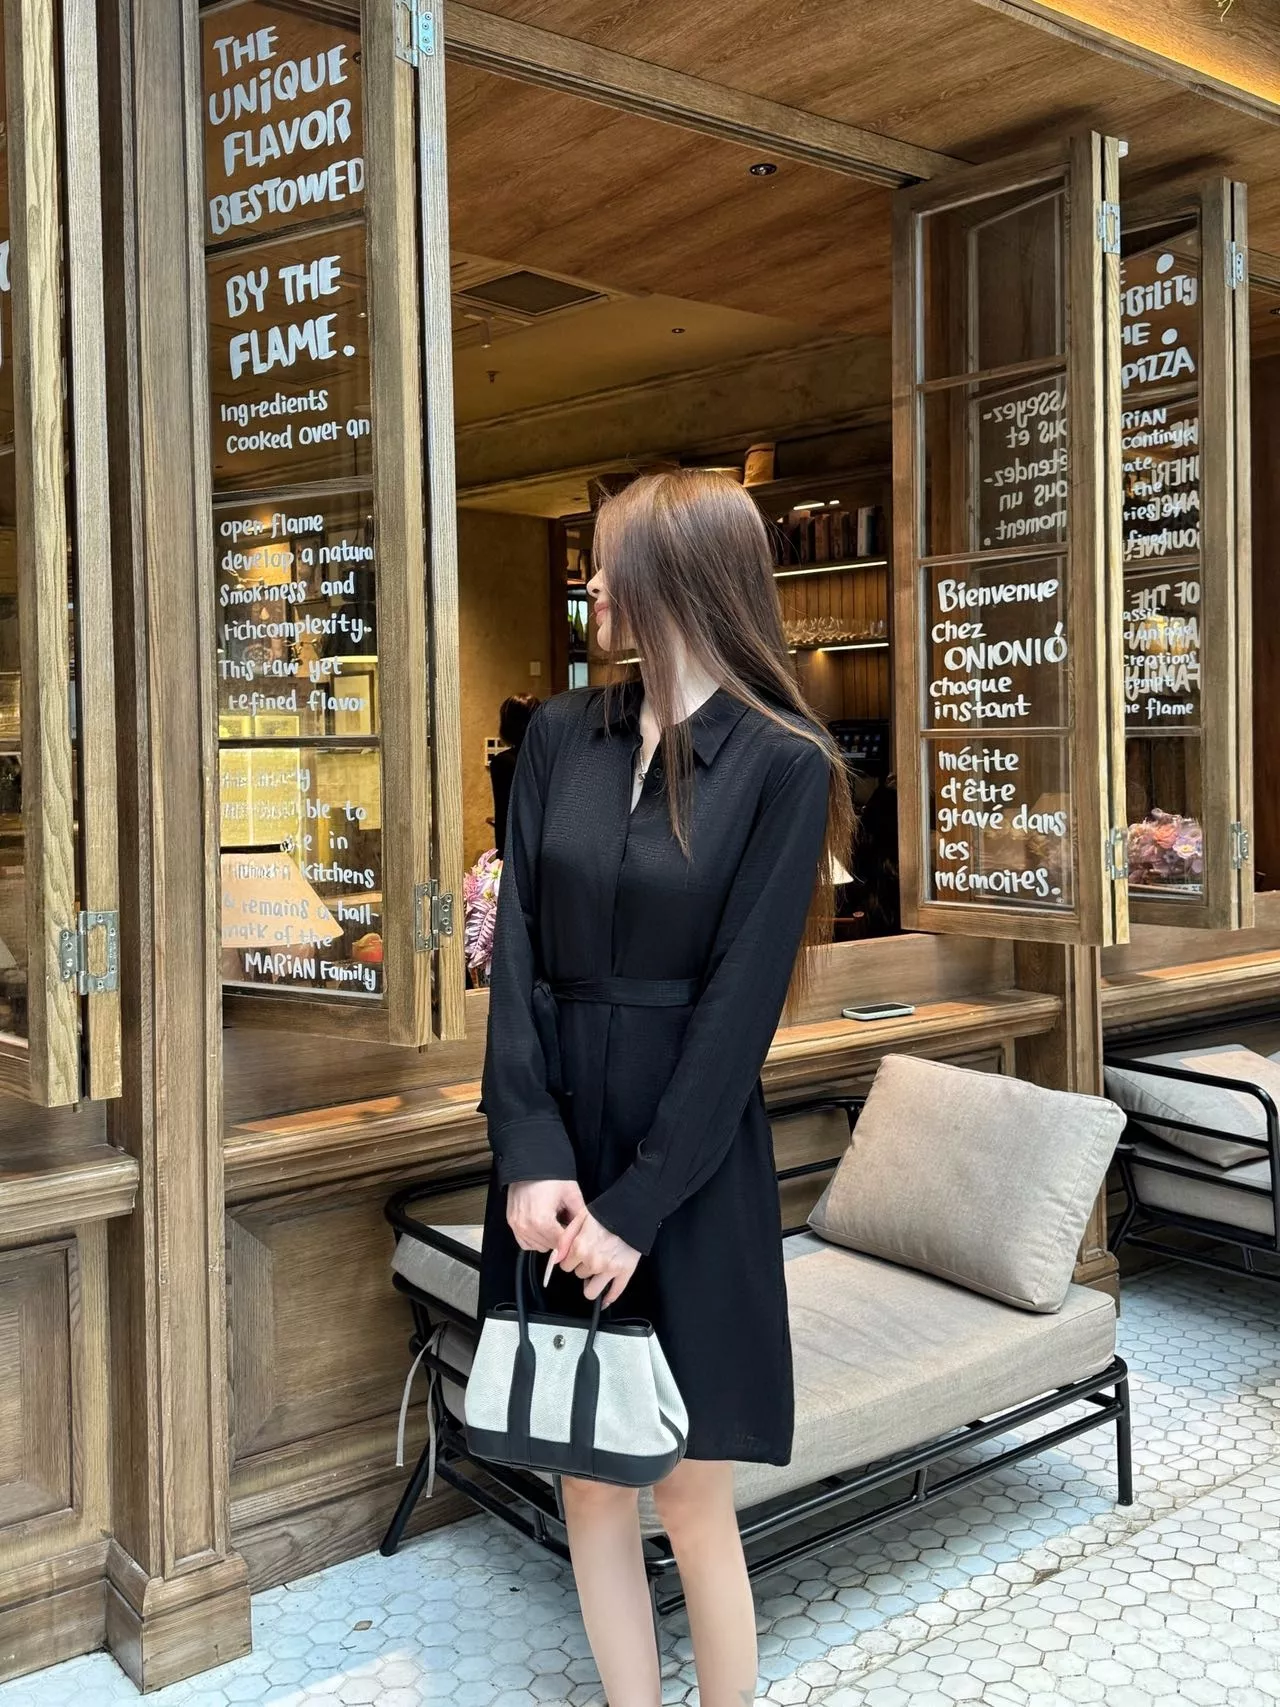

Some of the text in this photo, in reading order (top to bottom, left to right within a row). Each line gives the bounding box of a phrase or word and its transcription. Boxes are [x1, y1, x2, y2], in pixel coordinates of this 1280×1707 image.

[212, 25, 279, 77] THE
[223, 98, 352, 177] FLAVOR
[209, 157, 365, 235] BESTOWED
[225, 255, 341, 318] BY THE
[229, 312, 355, 380] FLAME.
[220, 389, 329, 427] Ingredients
[298, 421, 343, 445] over
[346, 418, 370, 439] an
[1122, 456, 1153, 472] ate
[220, 512, 324, 543] open flame
[221, 539, 375, 573] develop a natura
[320, 571, 355, 596] and
[937, 578, 1060, 613] Bienvenue
[219, 656, 343, 683] This raw yet
[228, 688, 365, 717] refined flavor
[934, 694, 1032, 722] instant
[1145, 697, 1194, 720] flame
[938, 746, 1019, 773] mérite
[940, 777, 1016, 804] d'être
[342, 800, 367, 821] to
[938, 803, 1068, 837] gravé dans
[329, 831, 349, 849] in
[939, 838, 970, 861] les
[935, 865, 1061, 897] mémoires.
[242, 896, 309, 920] remains
[274, 925, 293, 948] of
[299, 928, 332, 950] the
[320, 961, 376, 991] Family
